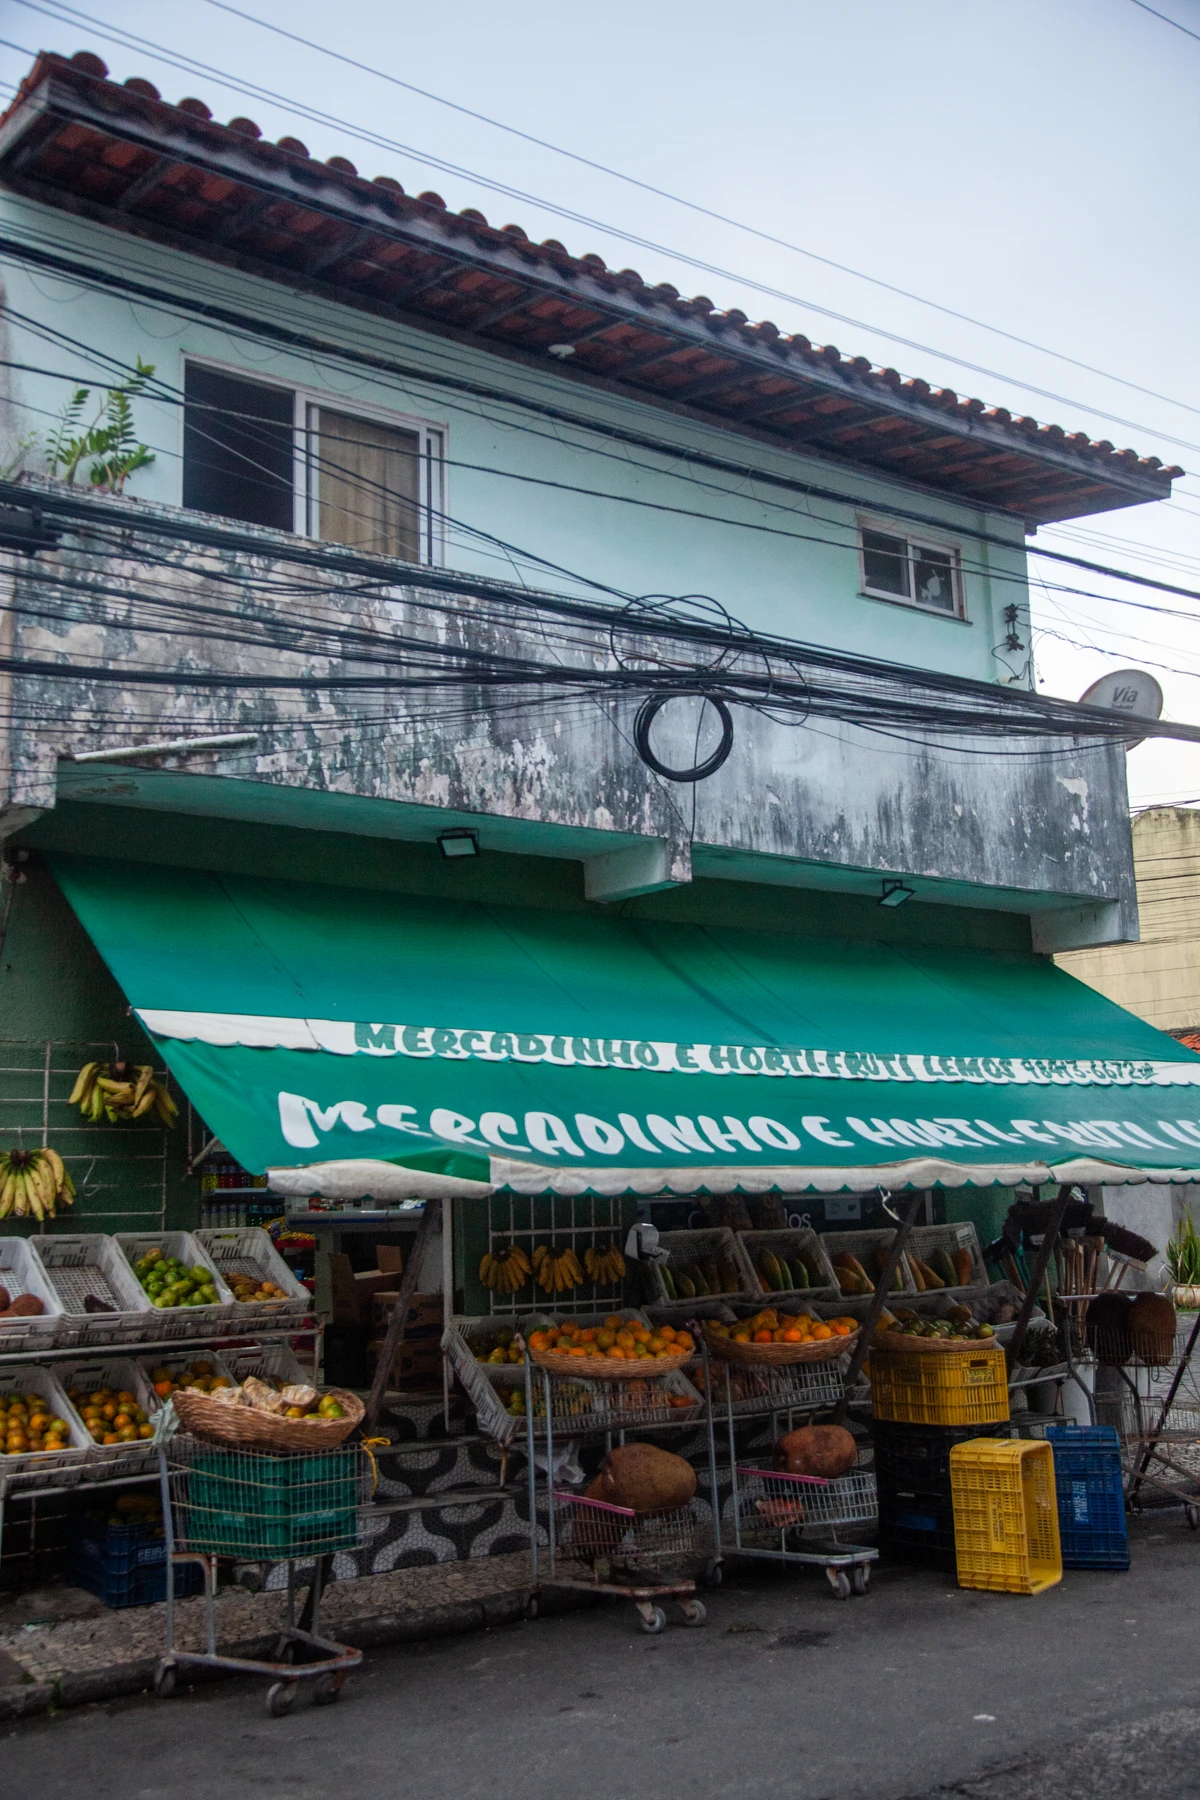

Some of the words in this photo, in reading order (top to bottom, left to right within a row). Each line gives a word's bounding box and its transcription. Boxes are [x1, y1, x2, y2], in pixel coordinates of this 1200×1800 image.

[1112, 686, 1139, 702] Via
[353, 1022, 659, 1067] MERCADINHO
[676, 1043, 701, 1069] E
[709, 1046, 914, 1079] HORTI-FRUTI
[923, 1054, 1013, 1081] LEMOS
[278, 1091, 801, 1157] MERCADINHO
[801, 1115, 855, 1148] E
[845, 1116, 1164, 1150] HORTI-FRUTI
